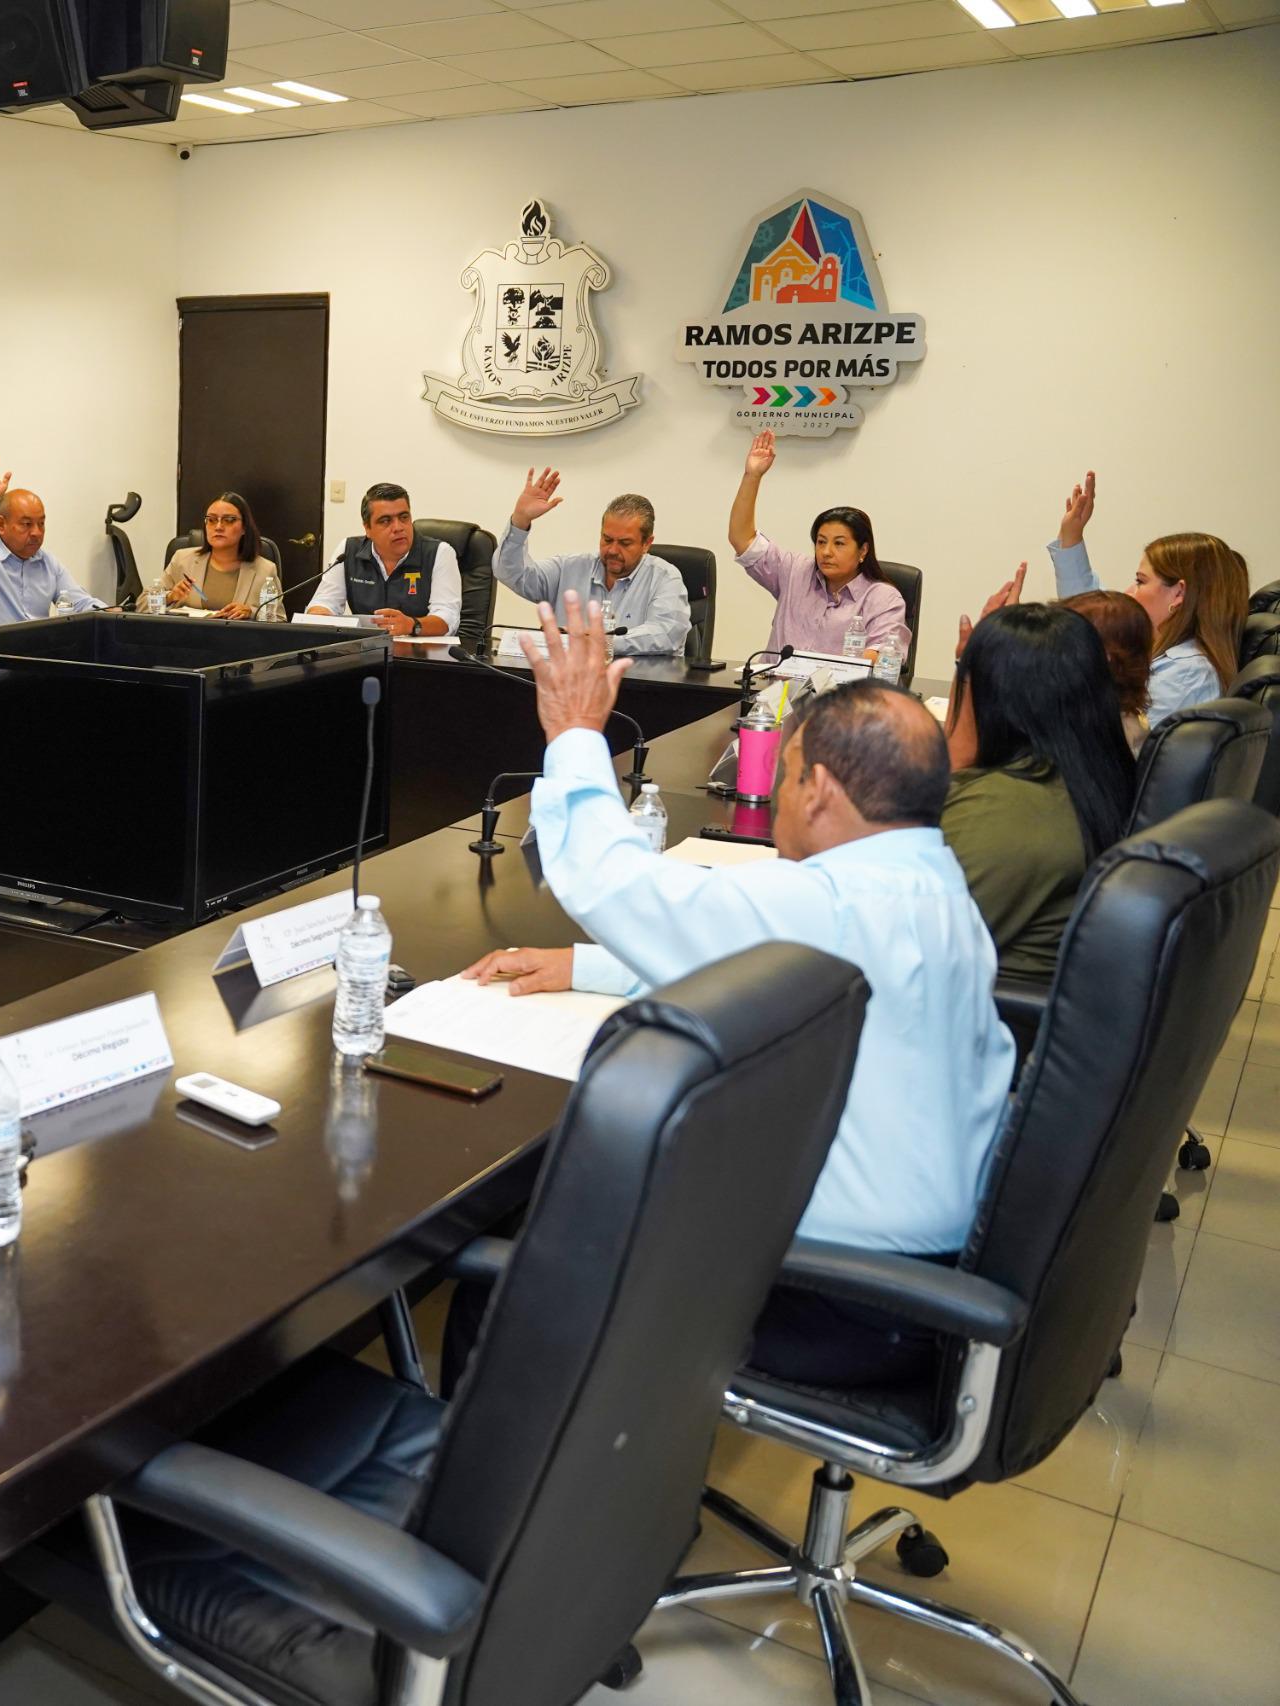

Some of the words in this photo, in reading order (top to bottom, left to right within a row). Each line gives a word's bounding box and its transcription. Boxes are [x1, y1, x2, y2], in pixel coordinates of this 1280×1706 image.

[685, 323, 793, 346] RAMOS
[797, 321, 916, 345] ARIZPE
[483, 345, 503, 387] RAMOS
[550, 344, 573, 387] ARIZPE
[703, 360, 777, 379] TODOS
[783, 359, 831, 378] POR
[835, 353, 890, 377] MÁS
[450, 404, 460, 414] EN
[460, 409, 468, 418] EL
[469, 413, 505, 426] ESFUERZO
[505, 419, 545, 428] FUNDAMOS
[545, 415, 580, 427] NUESTRO
[579, 406, 605, 422] VALER
[736, 410, 791, 419] GOBIERNO
[794, 411, 855, 419] MUNICIPAL
[758, 421, 786, 429] 2025
[802, 421, 831, 429] 2027
[16, 880, 36, 890] PHILIPS
[101, 1036, 130, 1051] Regidor
